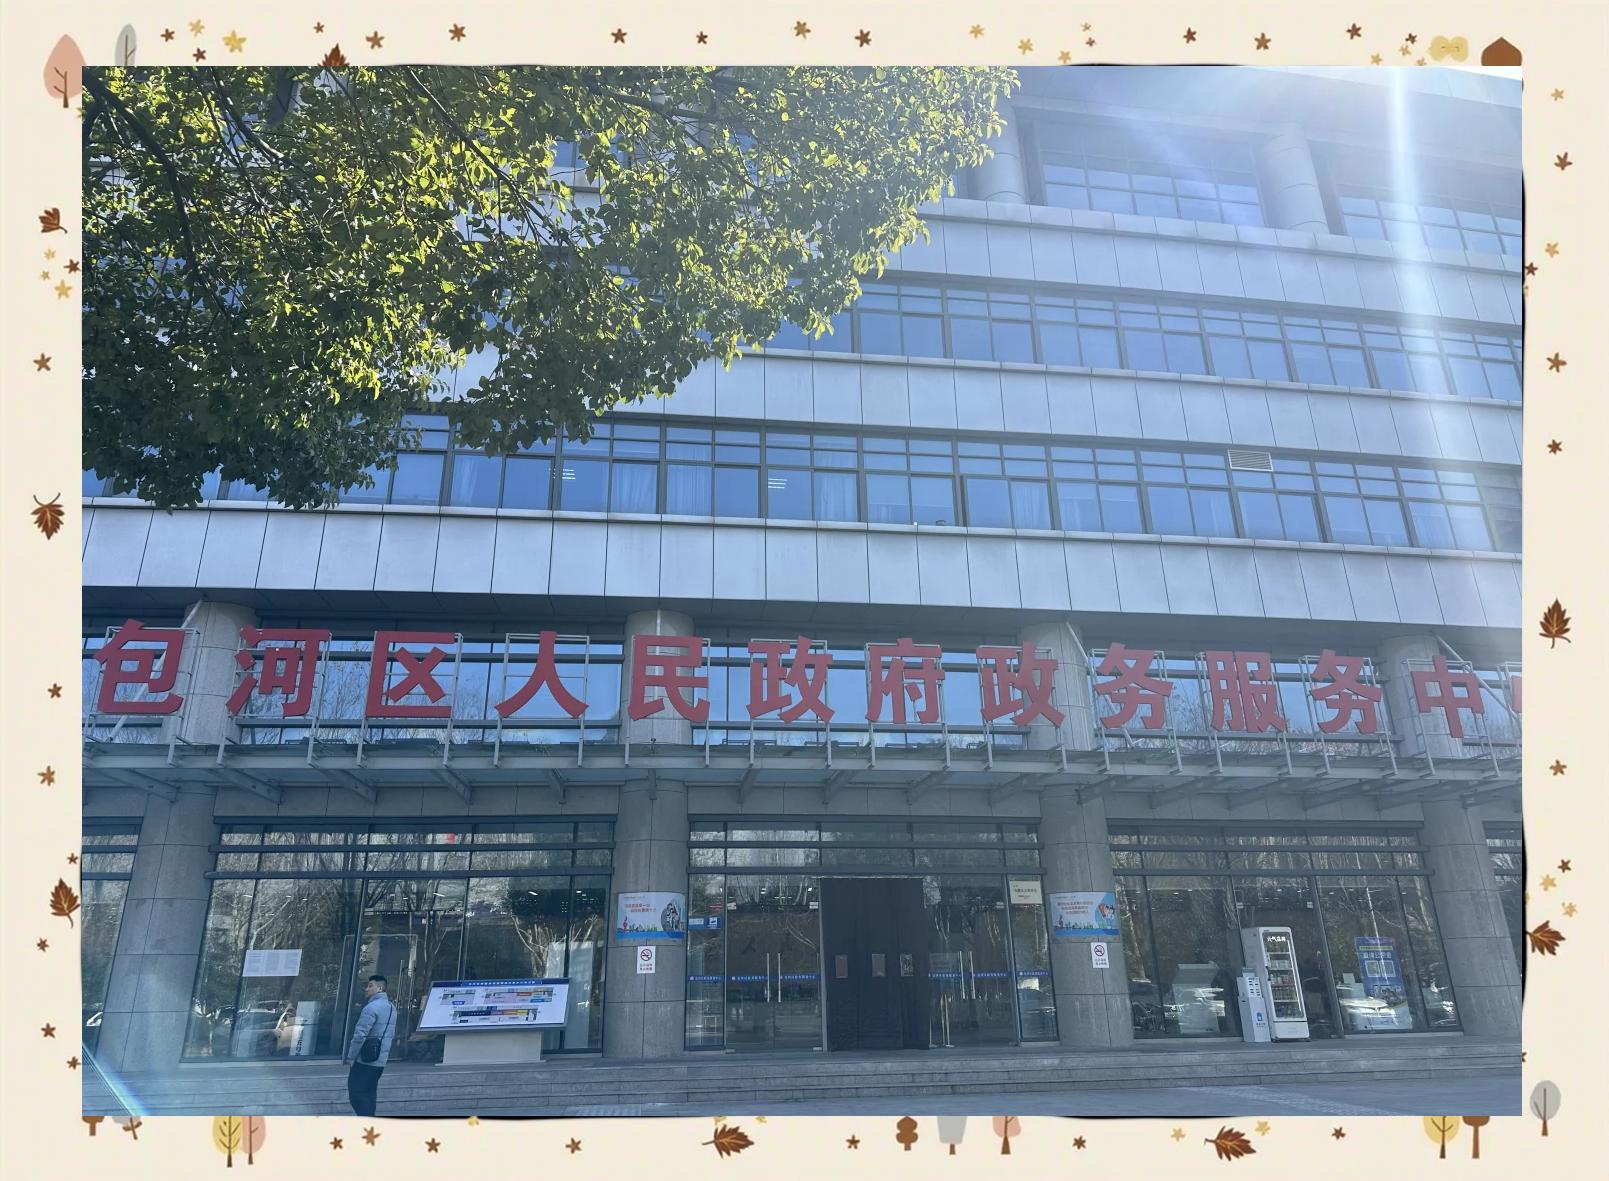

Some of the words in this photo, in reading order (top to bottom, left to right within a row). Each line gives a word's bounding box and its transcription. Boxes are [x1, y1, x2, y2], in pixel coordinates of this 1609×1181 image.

[94, 618, 1522, 738] 包河区人民政府政务服务中
